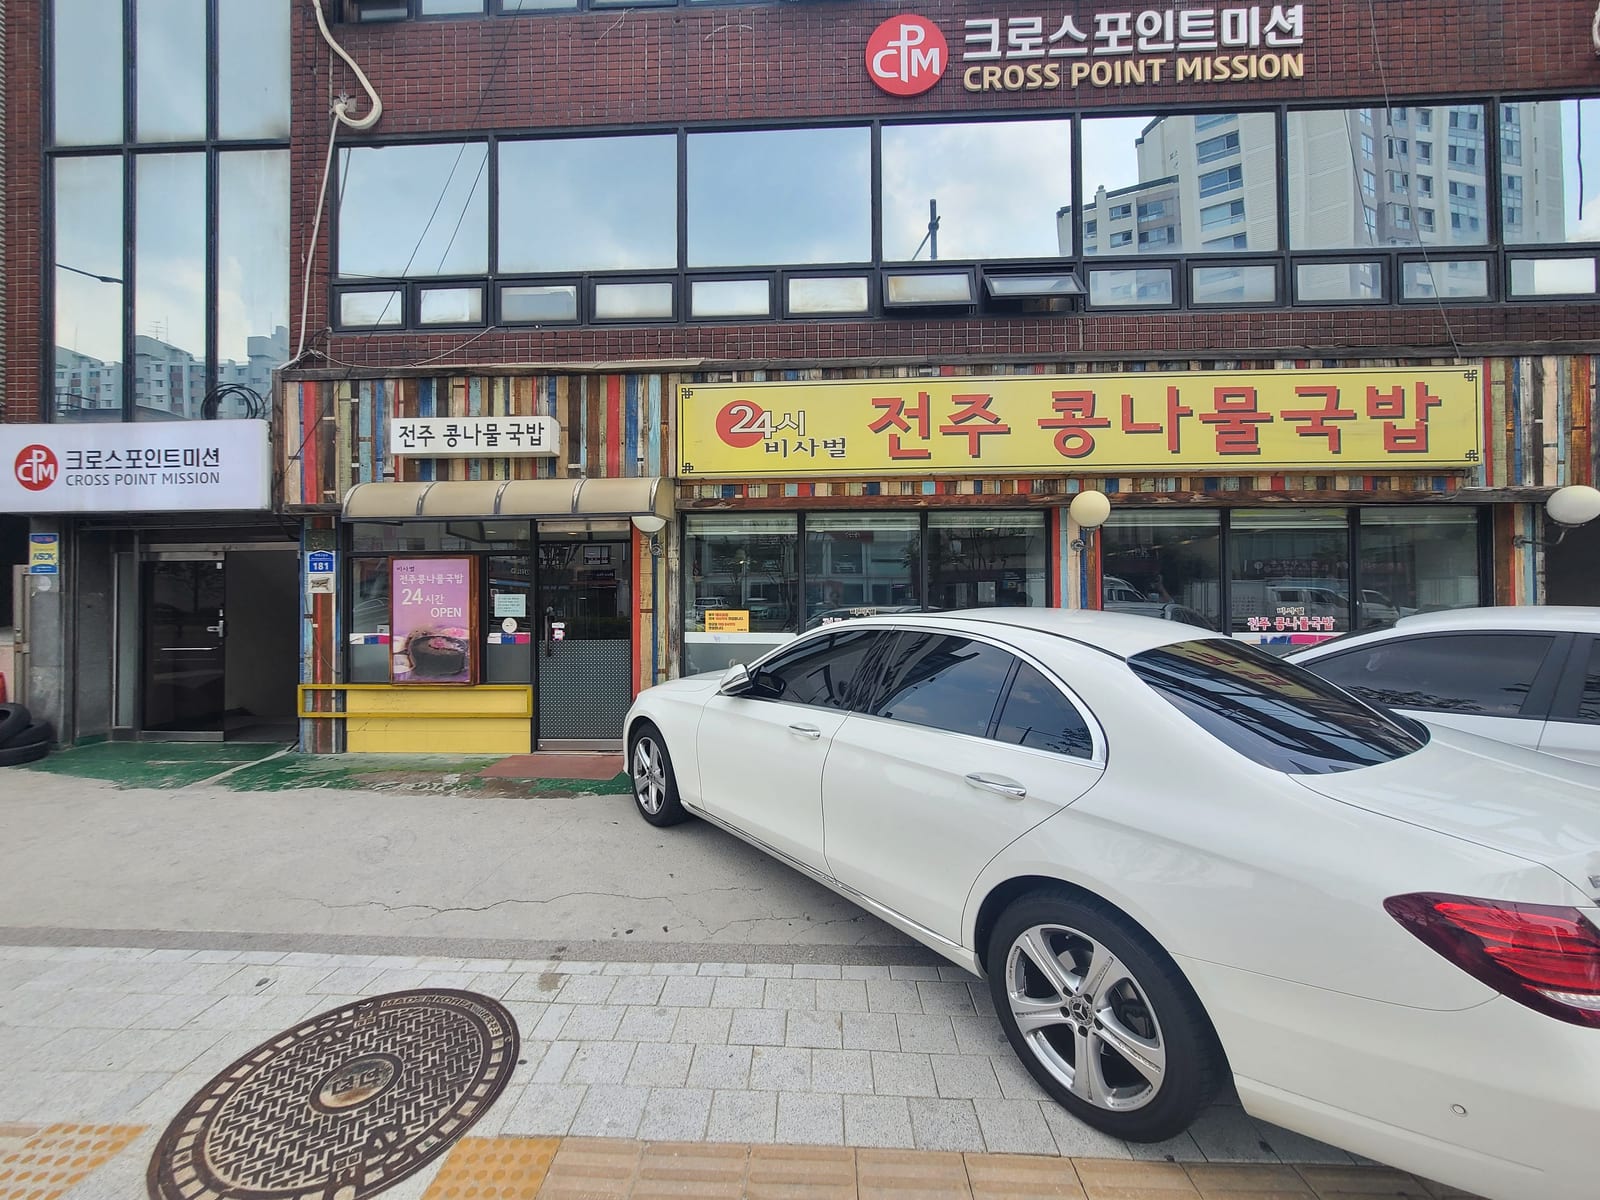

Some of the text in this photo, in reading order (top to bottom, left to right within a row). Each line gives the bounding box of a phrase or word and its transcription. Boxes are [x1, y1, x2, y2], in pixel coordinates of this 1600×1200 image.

[963, 4, 1304, 61] 크로스포인트미션
[963, 53, 1304, 92] CROSS POINT MISSION
[729, 404, 806, 439] 24시
[868, 381, 1442, 460] 전주 콩나물국밥
[399, 422, 545, 448] 전주 콩나물국밥
[65, 447, 220, 470] 크로스포인트미션
[764, 437, 846, 458] 비사벌
[65, 472, 220, 486] CROSS POINT MISSION
[312, 562, 329, 571] 181
[401, 587, 446, 606] 24시간
[430, 607, 462, 618] OPEN
[1247, 616, 1271, 631] 전주
